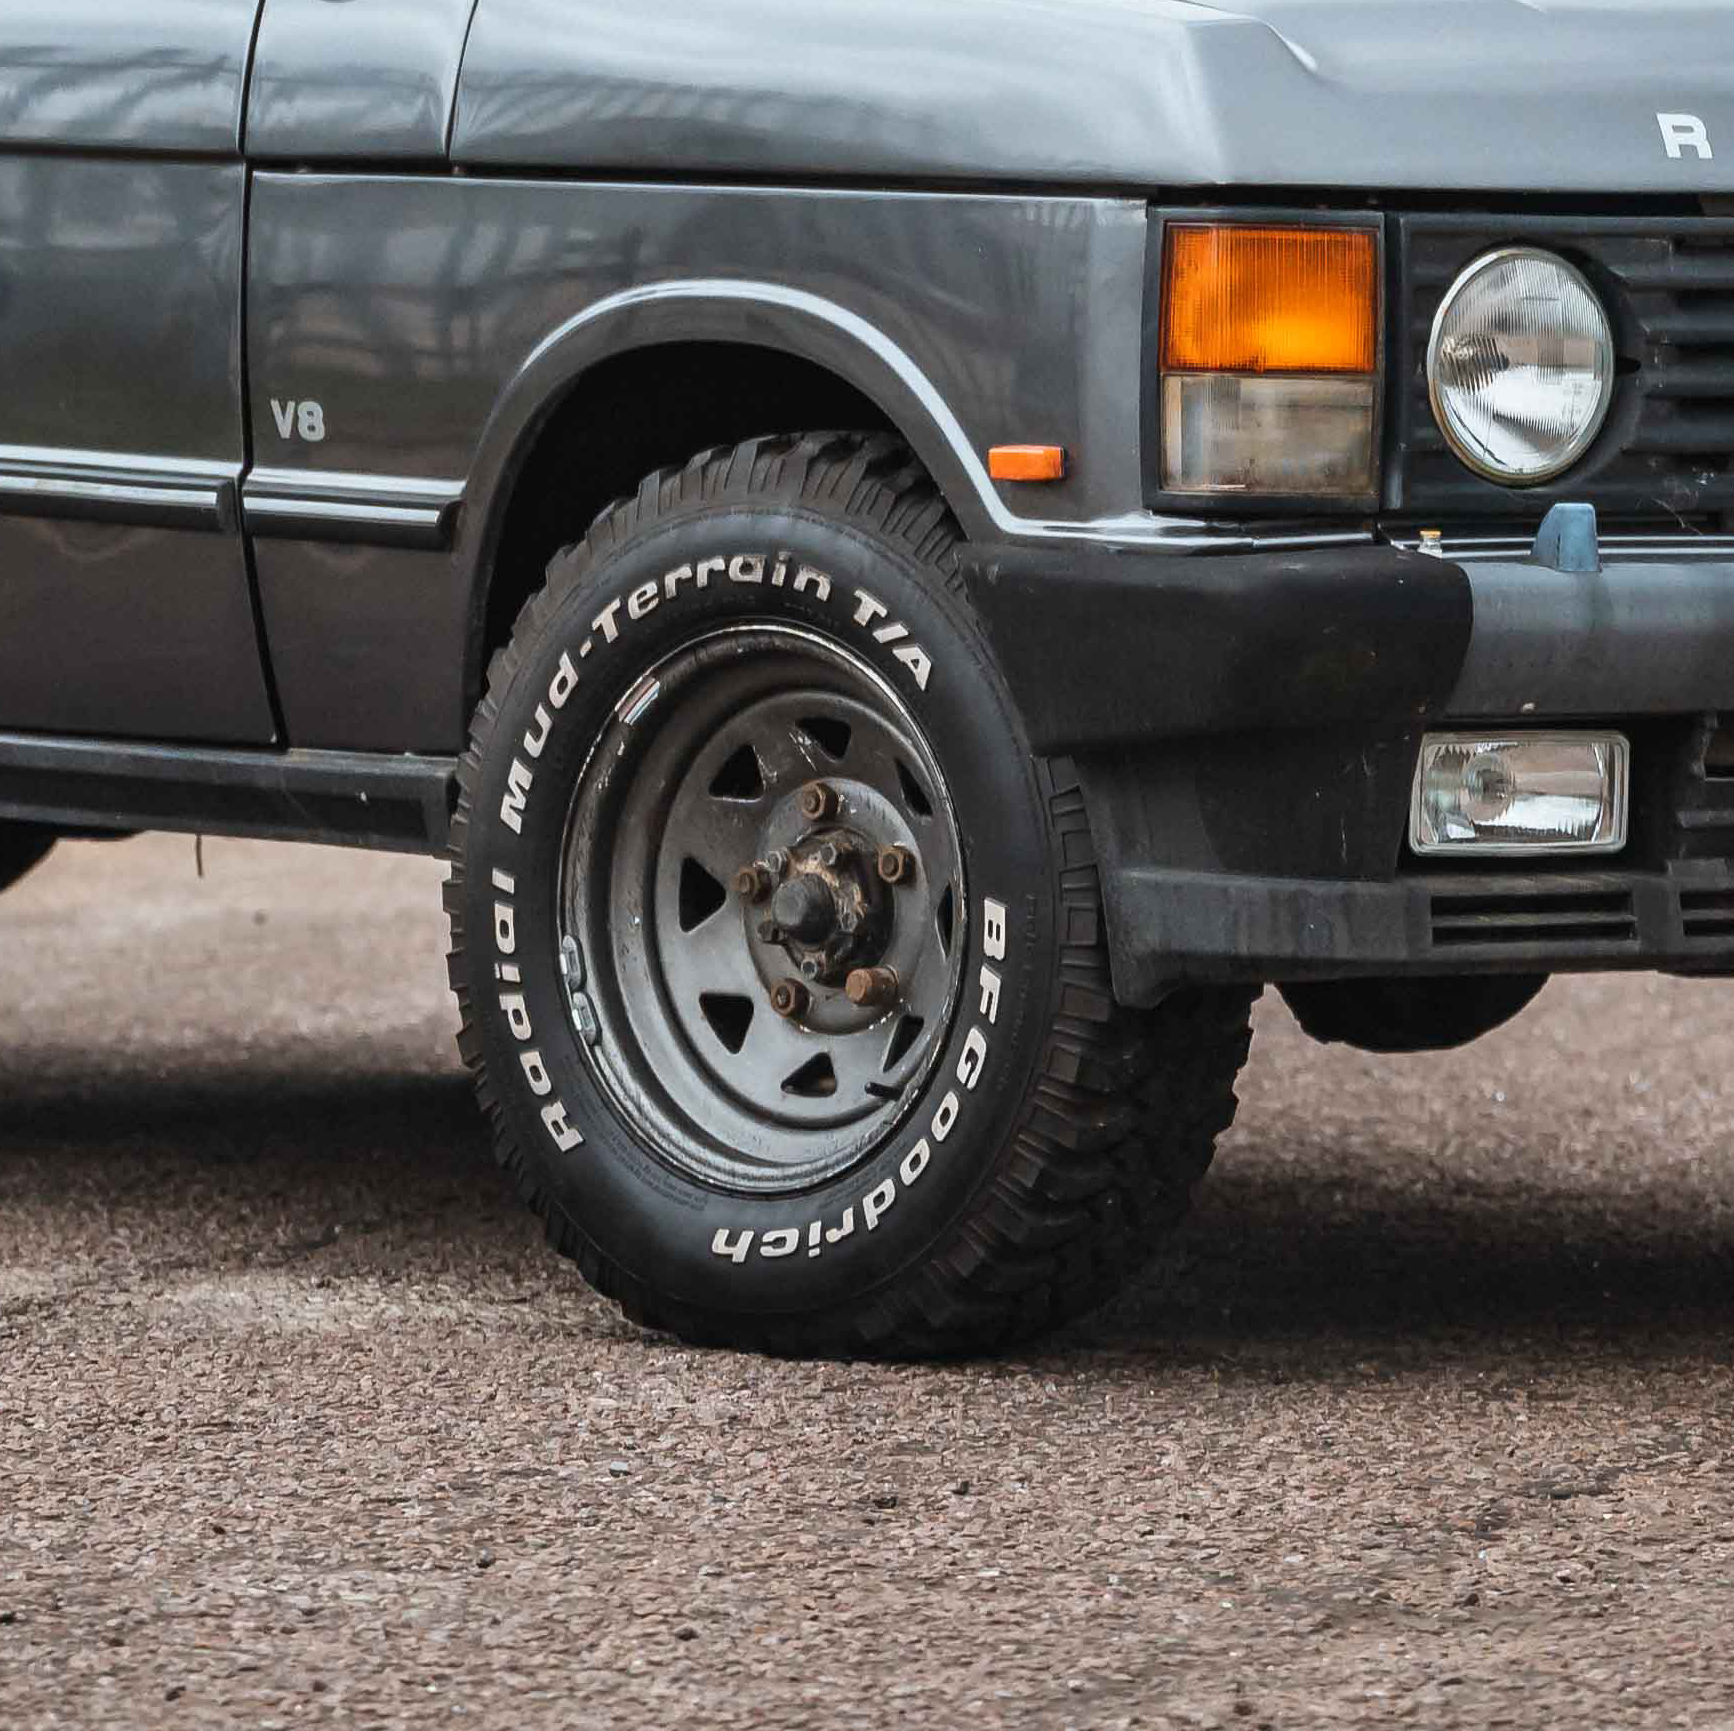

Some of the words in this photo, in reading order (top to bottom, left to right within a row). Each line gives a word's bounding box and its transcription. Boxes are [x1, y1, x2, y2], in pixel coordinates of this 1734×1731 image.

[270, 398, 326, 442] V8
[499, 552, 833, 836] Mud-Terrain
[492, 867, 585, 1153] Radial
[710, 896, 1009, 1265] BFGoodrich
